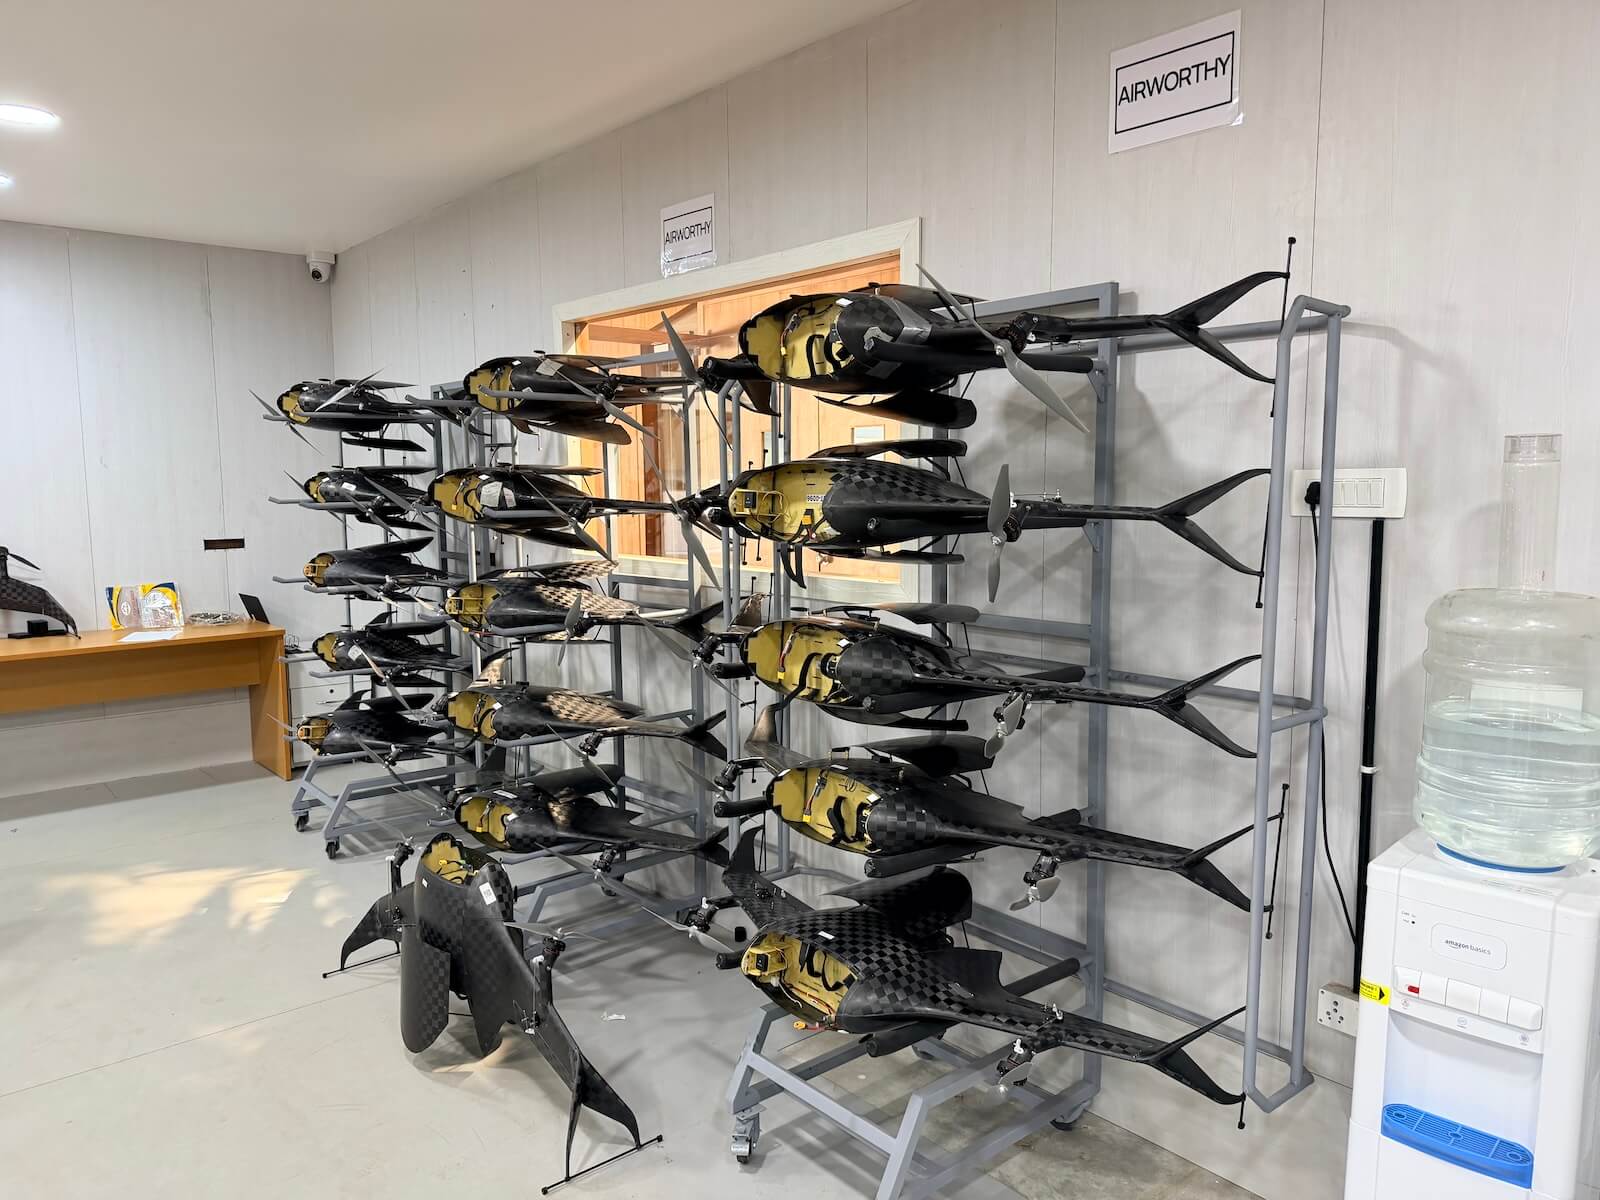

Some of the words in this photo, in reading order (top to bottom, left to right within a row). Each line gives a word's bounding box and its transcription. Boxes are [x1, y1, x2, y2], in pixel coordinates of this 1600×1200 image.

[1118, 53, 1231, 106] AIRWORTHY
[664, 221, 712, 245] AIRWORTHY
[1445, 939, 1469, 950] amazon
[1469, 944, 1492, 955] basics
